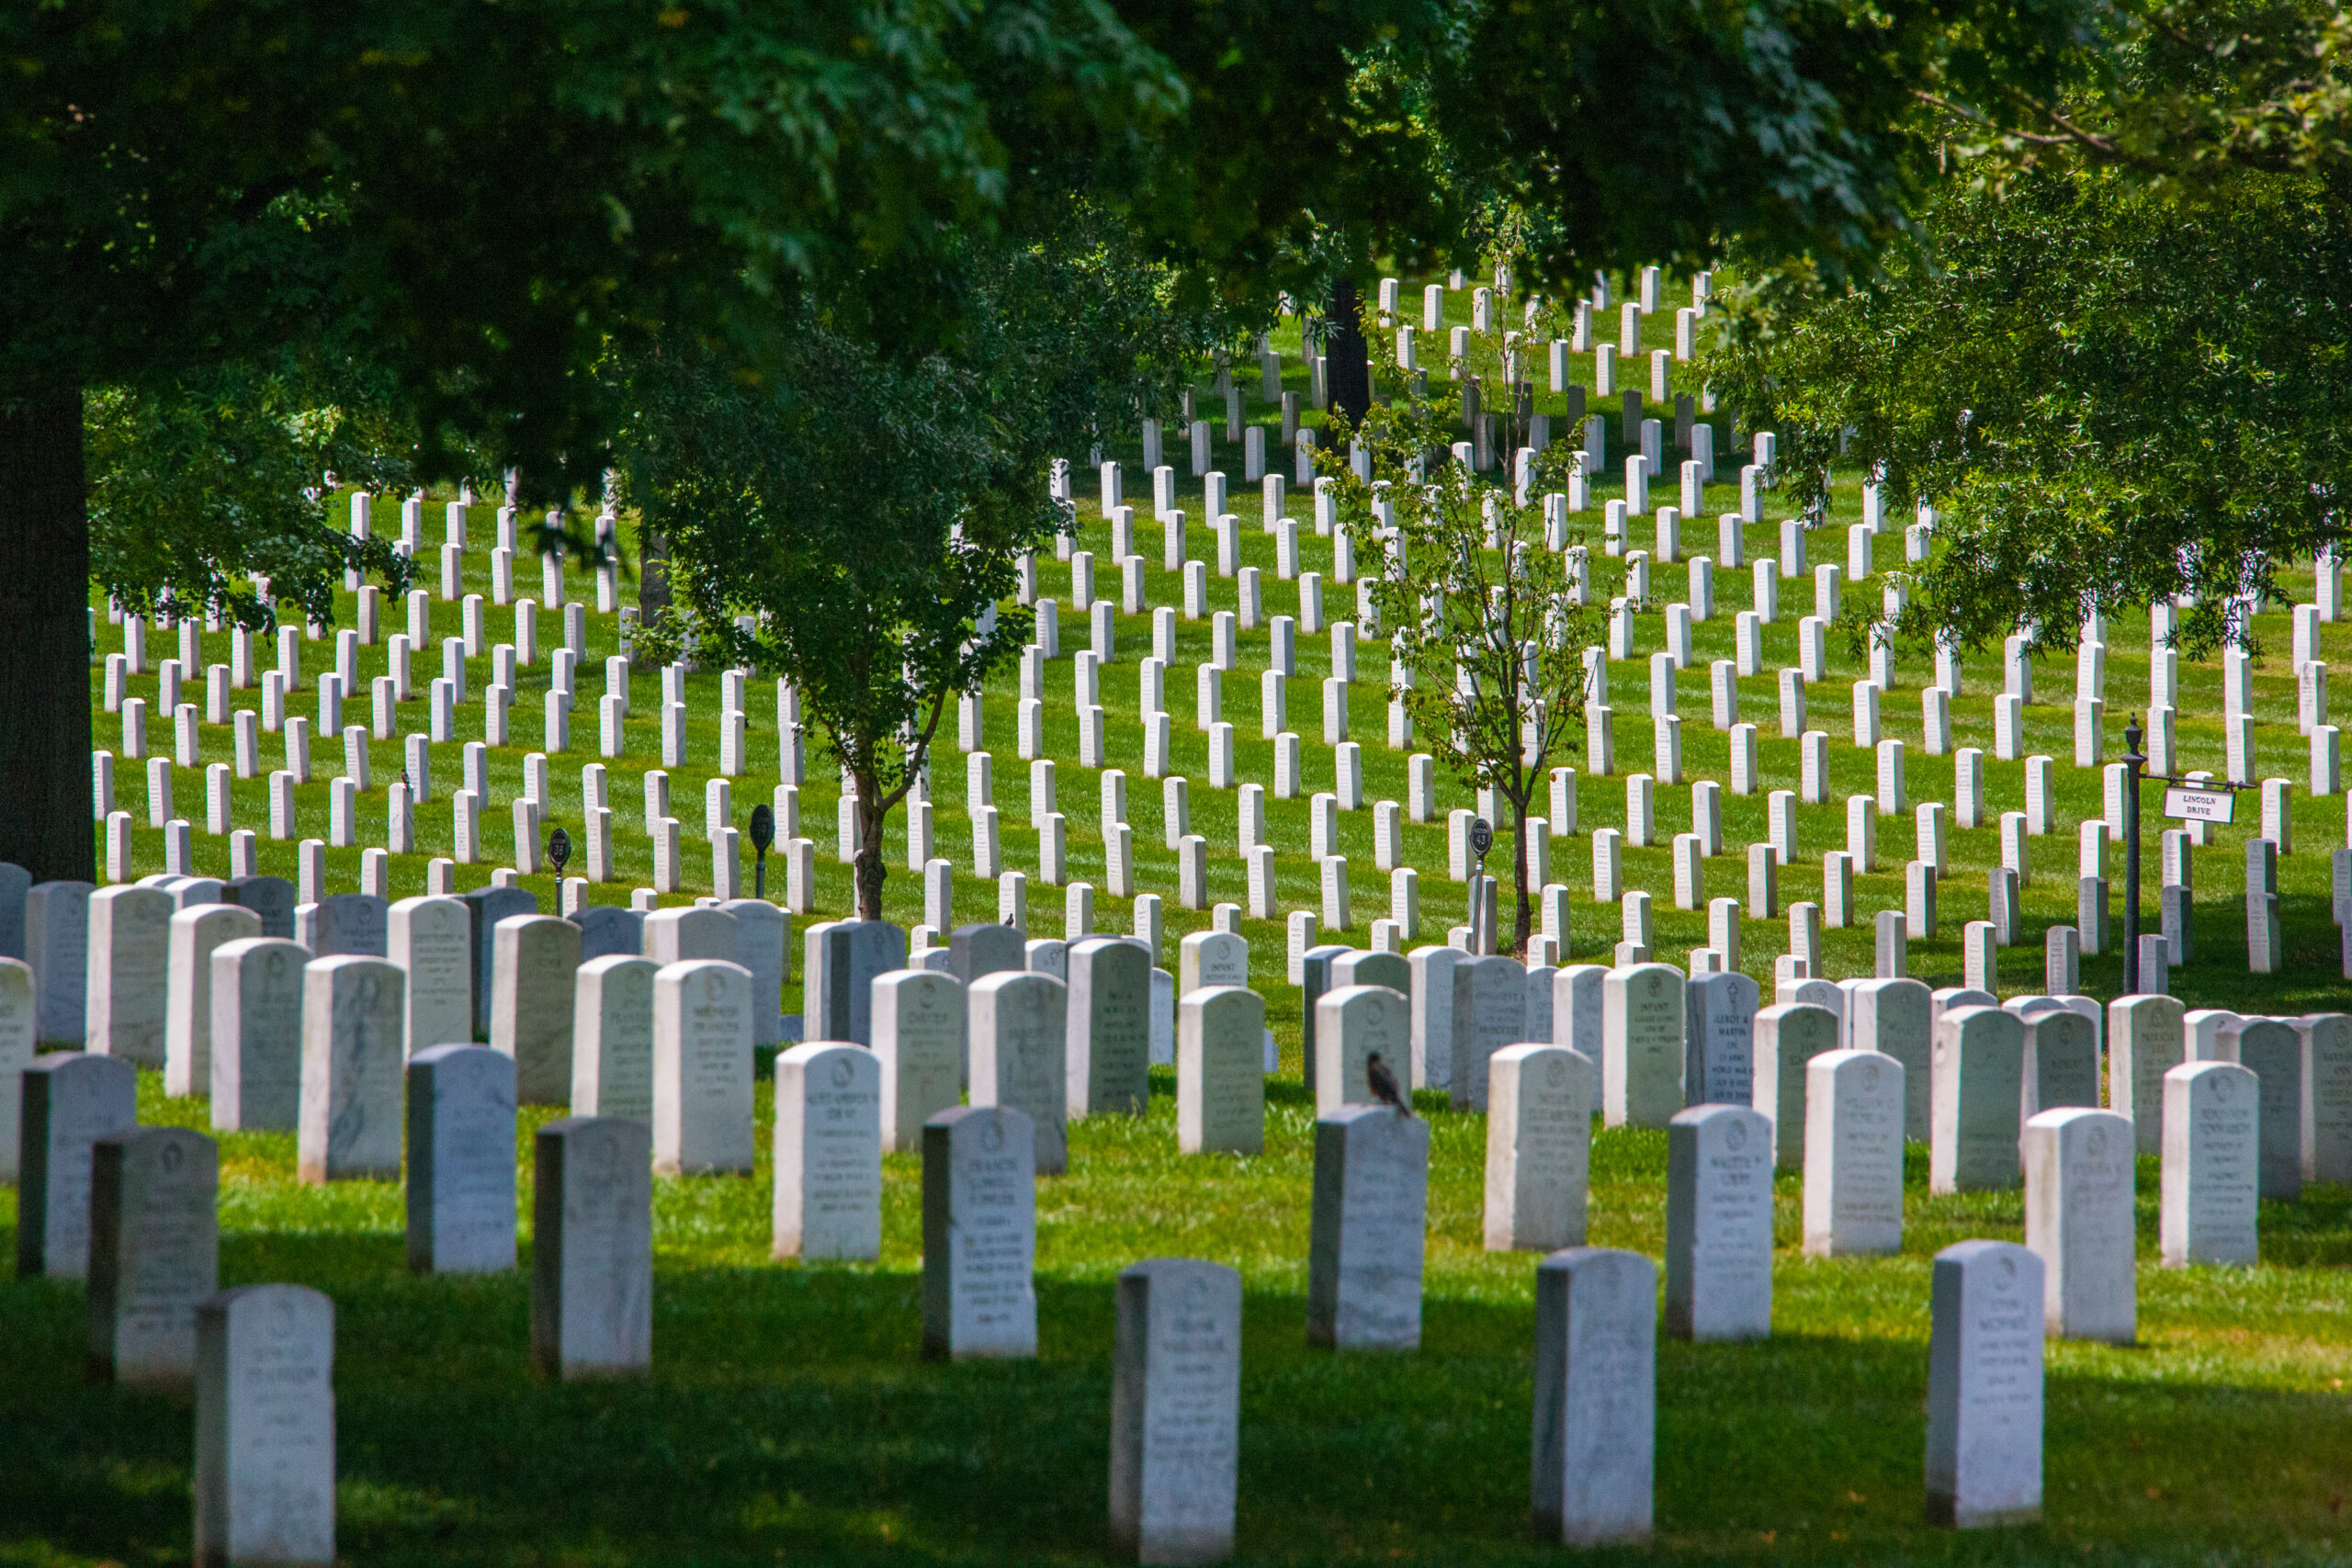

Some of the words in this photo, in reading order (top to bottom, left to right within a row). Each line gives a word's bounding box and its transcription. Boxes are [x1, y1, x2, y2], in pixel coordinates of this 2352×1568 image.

[2183, 795, 2216, 805] LINCOLN
[2187, 806, 2211, 815] DRIVE
[1719, 1027, 1747, 1036] MARTIN
